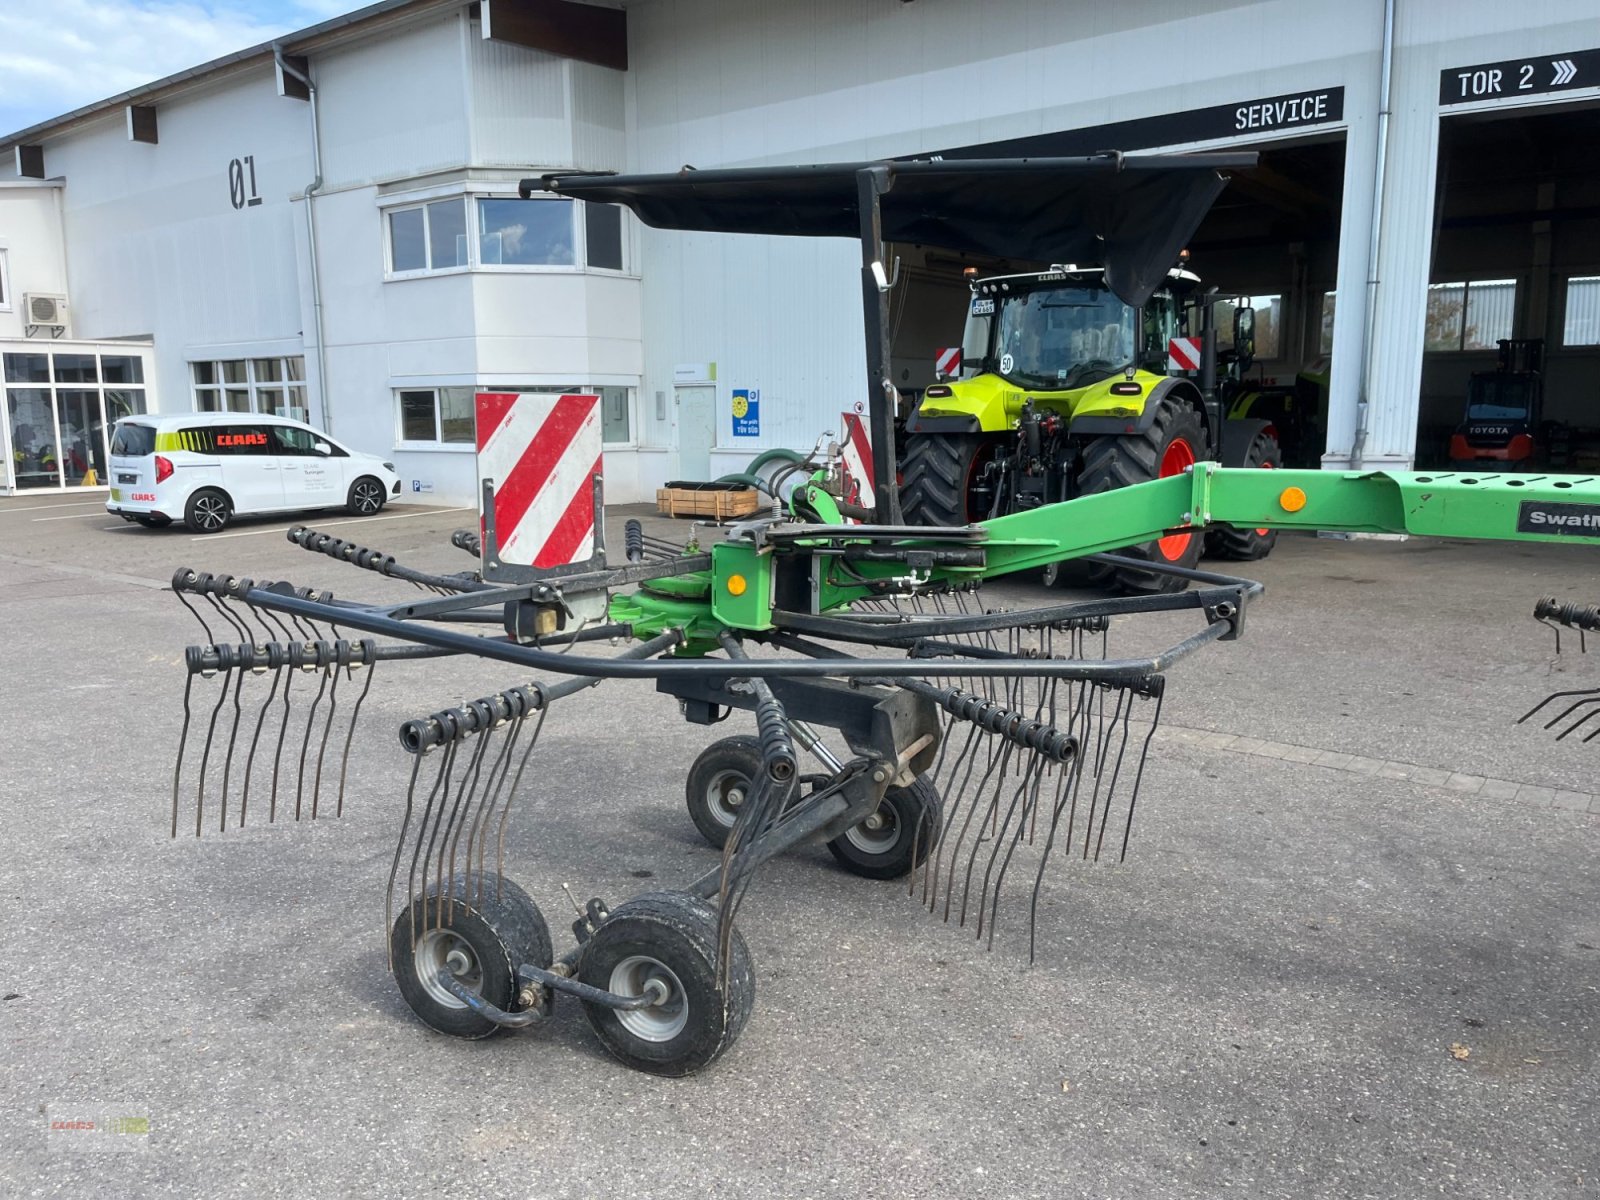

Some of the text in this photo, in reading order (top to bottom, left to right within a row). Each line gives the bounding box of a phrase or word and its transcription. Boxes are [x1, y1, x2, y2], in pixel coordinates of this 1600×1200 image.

[1458, 64, 1534, 97] TOR 2
[1235, 94, 1329, 130] SERVICE
[229, 155, 262, 210] 01
[1038, 273, 1067, 281] CLAAS
[1002, 357, 1012, 371] 50
[1469, 426, 1509, 435] TOYOTA
[217, 433, 268, 446] CLAAS
[414, 481, 420, 491] P
[131, 493, 156, 501] CLAAS
